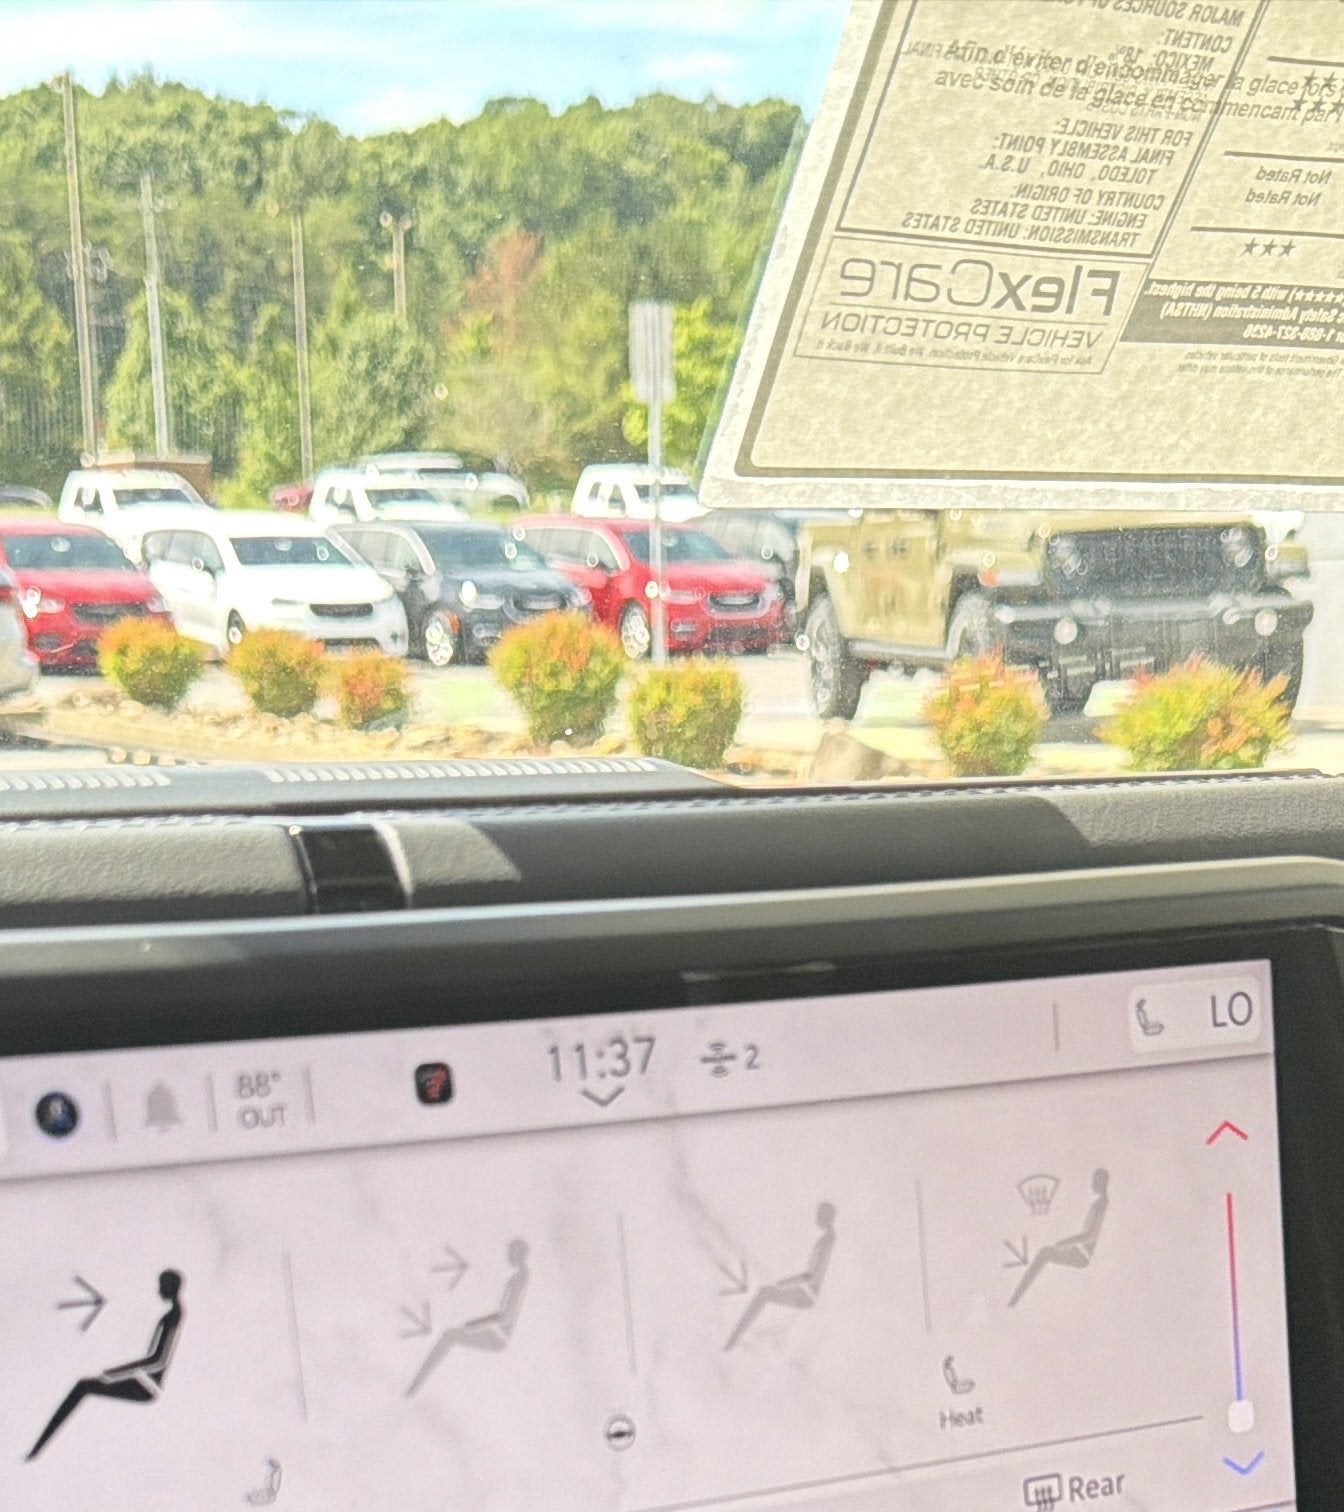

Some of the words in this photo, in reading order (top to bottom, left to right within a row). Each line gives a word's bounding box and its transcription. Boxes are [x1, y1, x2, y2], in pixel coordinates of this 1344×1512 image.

[1248, 73, 1298, 97] glace
[237, 1105, 288, 1131] OUT
[547, 1035, 657, 1082] 11:37
[742, 1043, 762, 1073] 2
[1209, 990, 1254, 1029] LO
[938, 1404, 985, 1430] Heat
[1067, 1473, 1125, 1503] Rear
